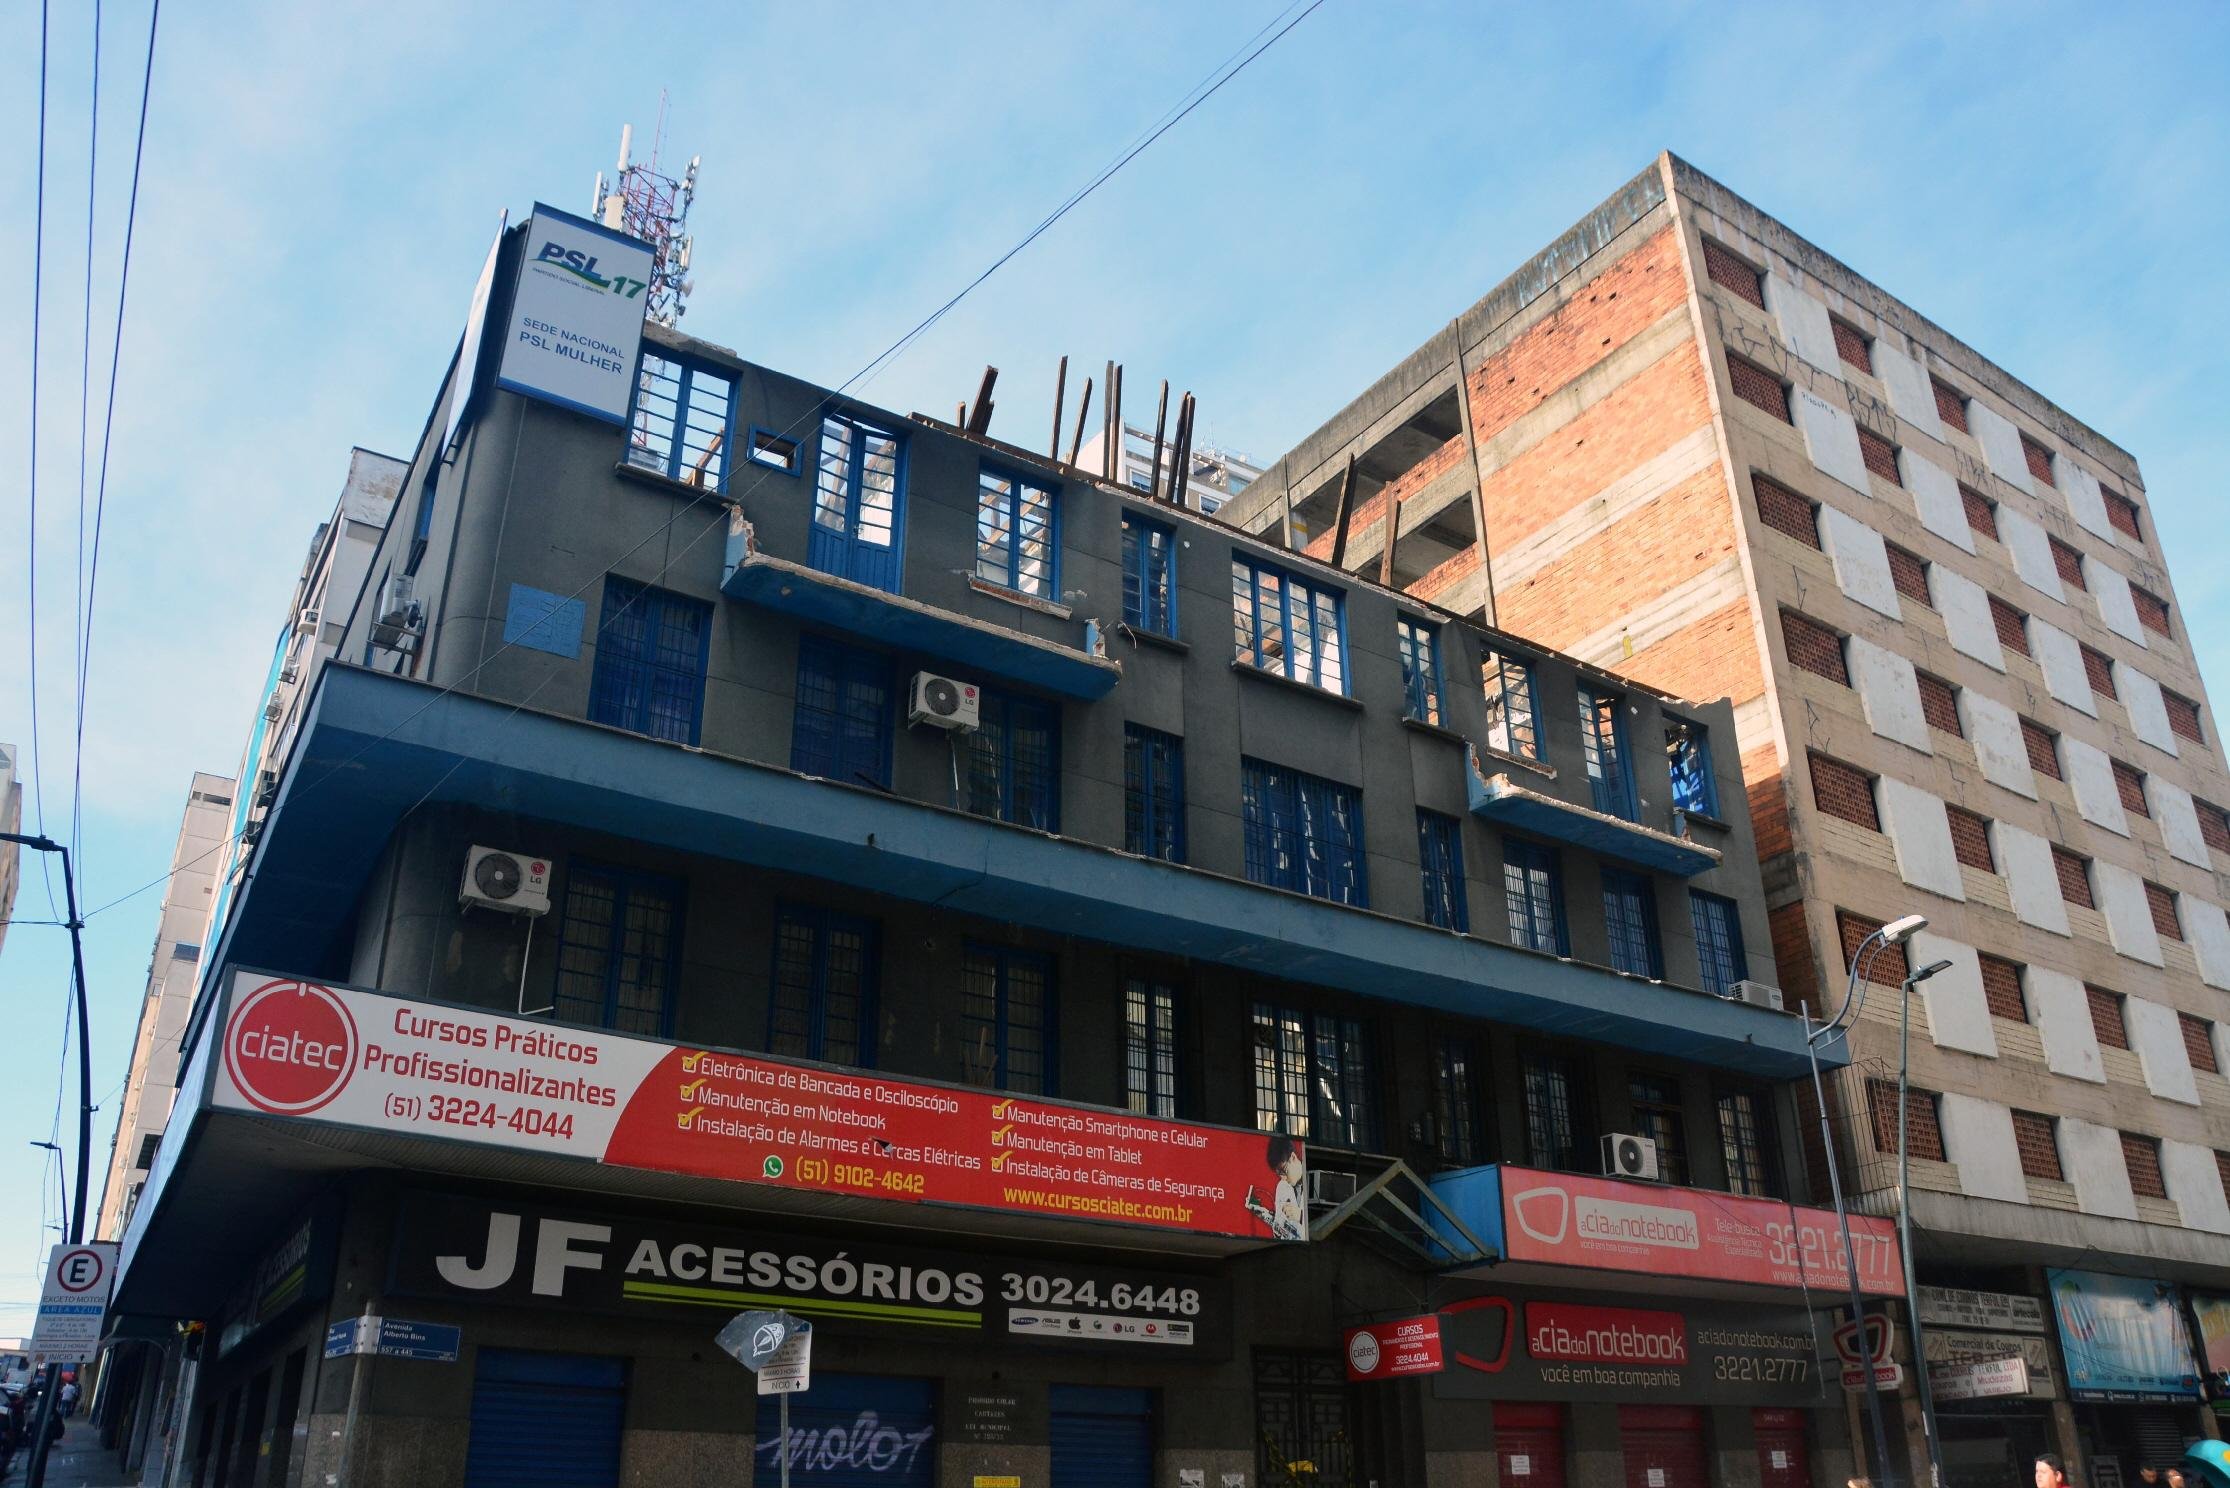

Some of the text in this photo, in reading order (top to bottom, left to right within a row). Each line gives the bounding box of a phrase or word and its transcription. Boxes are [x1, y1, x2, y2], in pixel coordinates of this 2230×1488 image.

[536, 241, 647, 299] PSL 17
[519, 331, 622, 375] PSL MULHER
[523, 317, 625, 359] SEDE NACIONAL
[530, 876, 542, 885] LG
[241, 1024, 343, 1072] ciatec
[394, 1008, 599, 1066] Cursos Práticos
[364, 1044, 616, 1107] Profissionalizantes
[701, 1059, 959, 1115] Eletrônica de Bancada e Osciloscópio
[384, 1092, 573, 1140] (51) 3224-4044
[698, 1087, 886, 1130] Manutenção em Notebook
[1007, 1105, 1209, 1150] Manutenção Smartphone e Celular
[697, 1115, 774, 1144] Instalação
[777, 1127, 796, 1145] de
[799, 1129, 858, 1154] Alarmes
[862, 1141, 870, 1155] e
[924, 1146, 981, 1170] Elétricas
[1007, 1132, 1142, 1166] Manutenção em Tablet
[795, 1156, 924, 1193] (51) 9102-4642
[1006, 1158, 1225, 1202] Instalação de Câmeras de Segurança
[1003, 1187, 1193, 1223] www.cursosciatec.com.br
[69, 1258, 89, 1283] E
[436, 1212, 1200, 1315] JF ACESSÓRIOS 3024.6448
[43, 1295, 106, 1303] EXCETO MOTOS
[384, 1330, 409, 1339] Alberto
[385, 1322, 413, 1331] Avenida
[1124, 1325, 1135, 1333] LG
[1397, 1324, 1424, 1337] CURSOS
[1353, 1346, 1376, 1358] ciatec
[1714, 1355, 1807, 1382] 3221.2777
[1541, 1364, 1681, 1389] você em boa companhia
